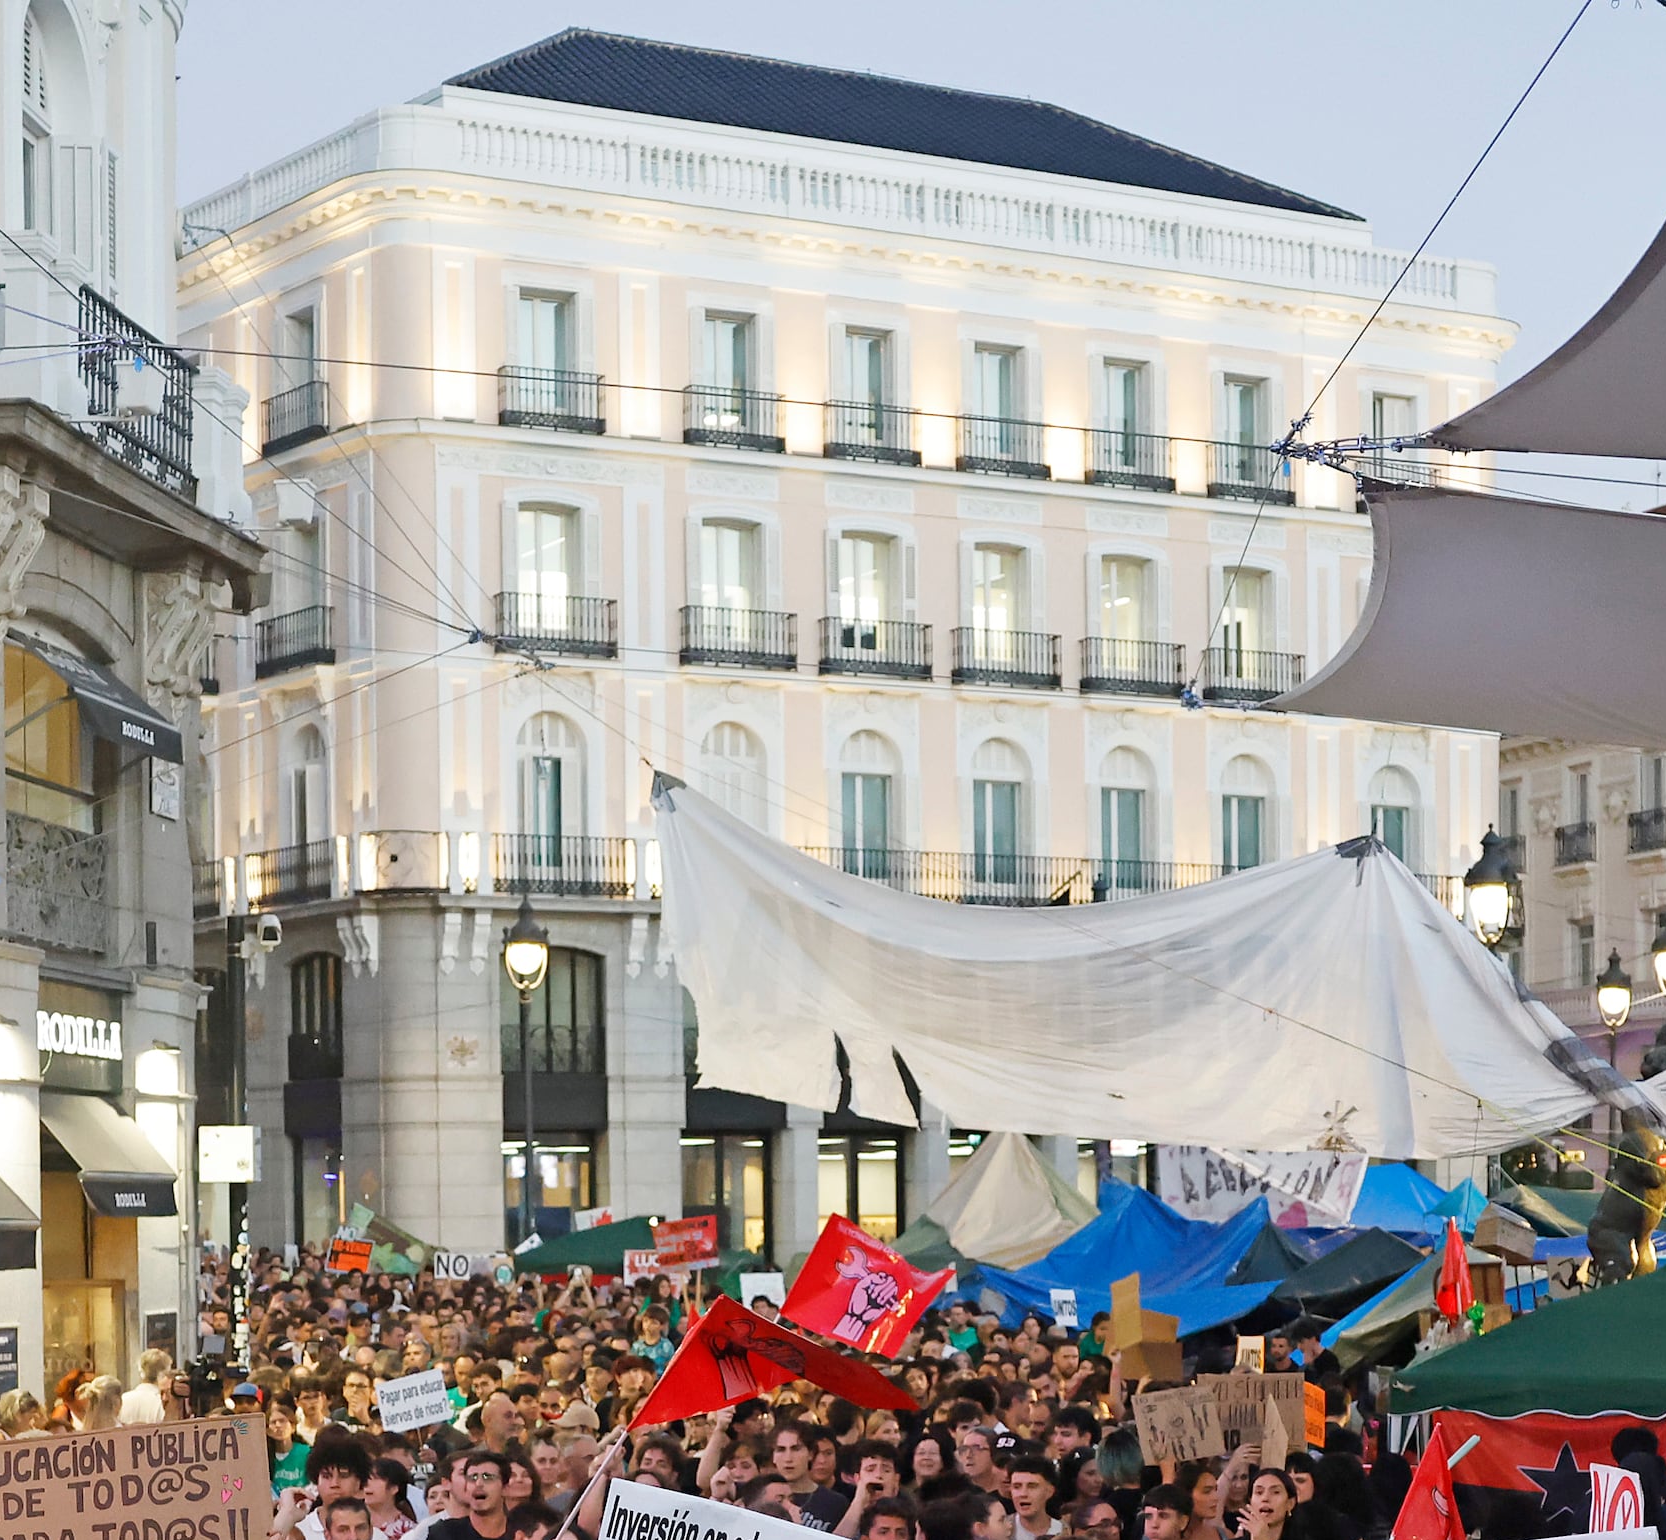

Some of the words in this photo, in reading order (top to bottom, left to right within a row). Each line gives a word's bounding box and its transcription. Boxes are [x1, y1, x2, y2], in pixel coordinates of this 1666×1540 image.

[122, 720, 155, 746] RODILLA
[36, 1010, 122, 1060] RODILLA
[115, 1193, 146, 1208] RODILLA
[436, 1254, 469, 1278] NO
[402, 1386, 419, 1401] para
[996, 1433, 1016, 1448] 93
[3, 1488, 45, 1520] DE
[68, 1464, 211, 1514] TOD@S
